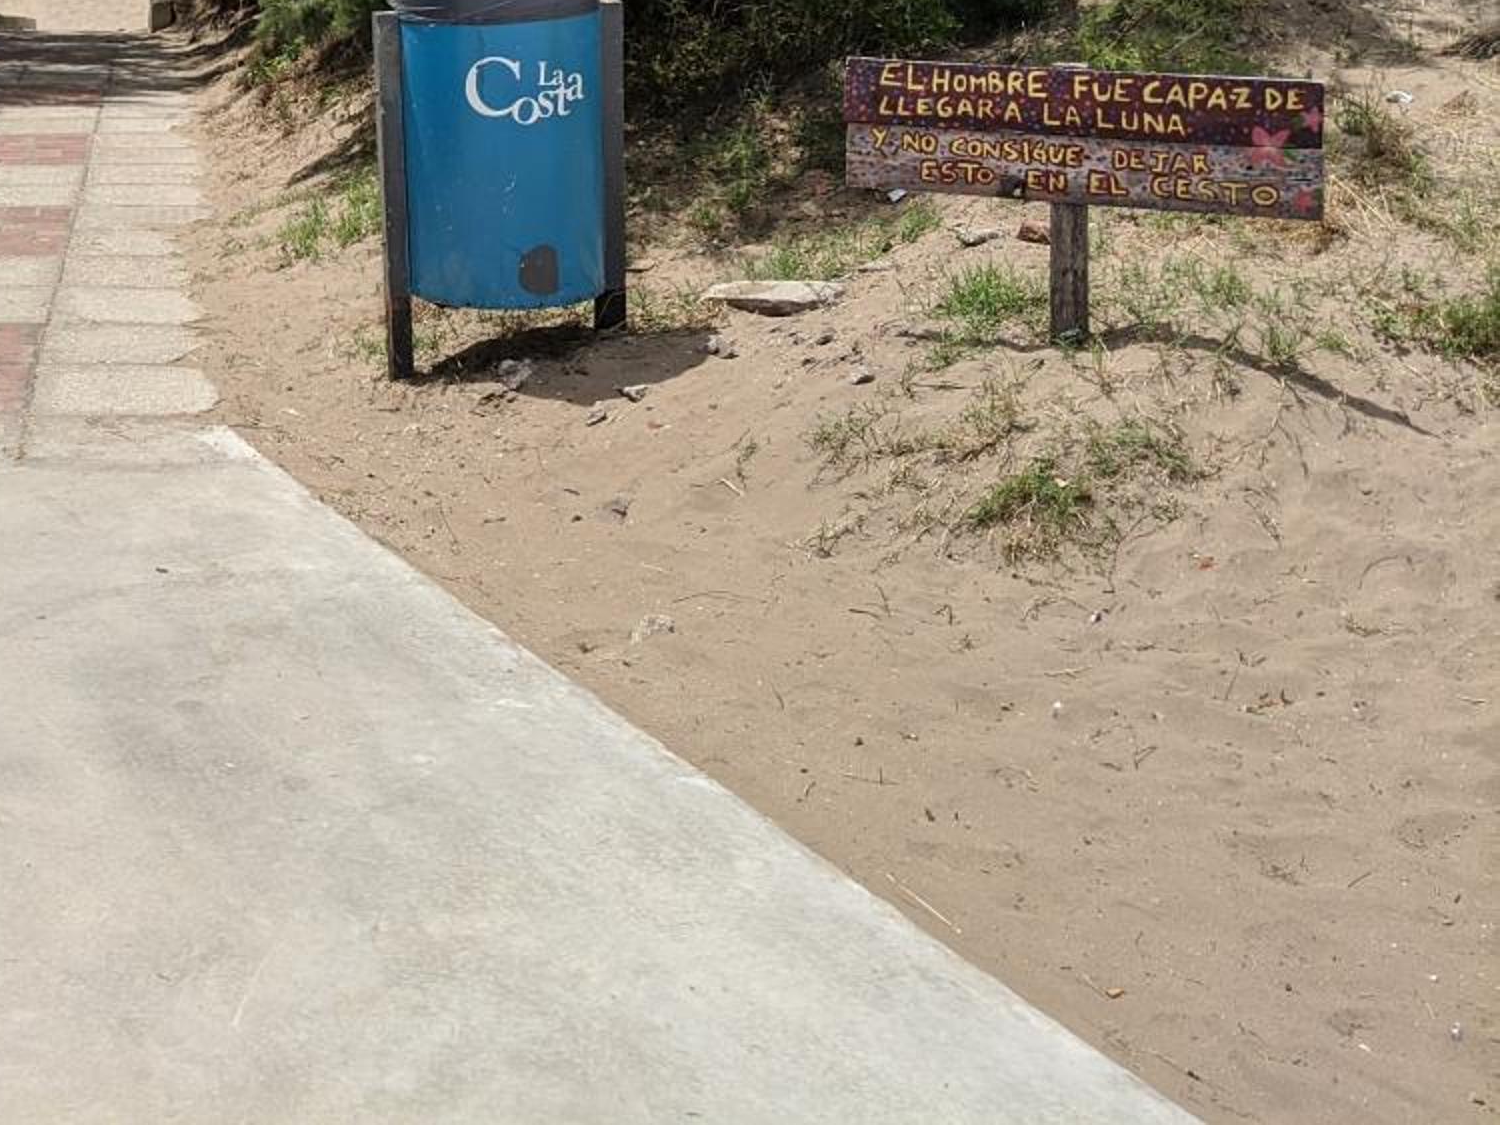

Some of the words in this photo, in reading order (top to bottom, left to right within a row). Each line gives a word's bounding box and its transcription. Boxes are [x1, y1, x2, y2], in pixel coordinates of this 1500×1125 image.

[465, 56, 584, 125] Costa
[538, 60, 564, 86] La
[880, 63, 925, 92] EL
[1073, 74, 1134, 103] FUE
[1143, 80, 1253, 111] CAPAZ
[1264, 87, 1305, 111] DE
[879, 96, 994, 120] LLEGAR
[1003, 105, 1023, 123] A
[1044, 102, 1082, 126] LA
[1096, 107, 1187, 137] LUNA
[871, 127, 888, 150] Y
[901, 131, 937, 153] NO
[950, 137, 1082, 167] CONSIGUE
[1114, 150, 1211, 174] DEJAR
[921, 161, 994, 184] ESTO
[1027, 169, 1066, 193] EN
[1089, 172, 1128, 196] EL
[1153, 175, 1280, 206] CESTO
